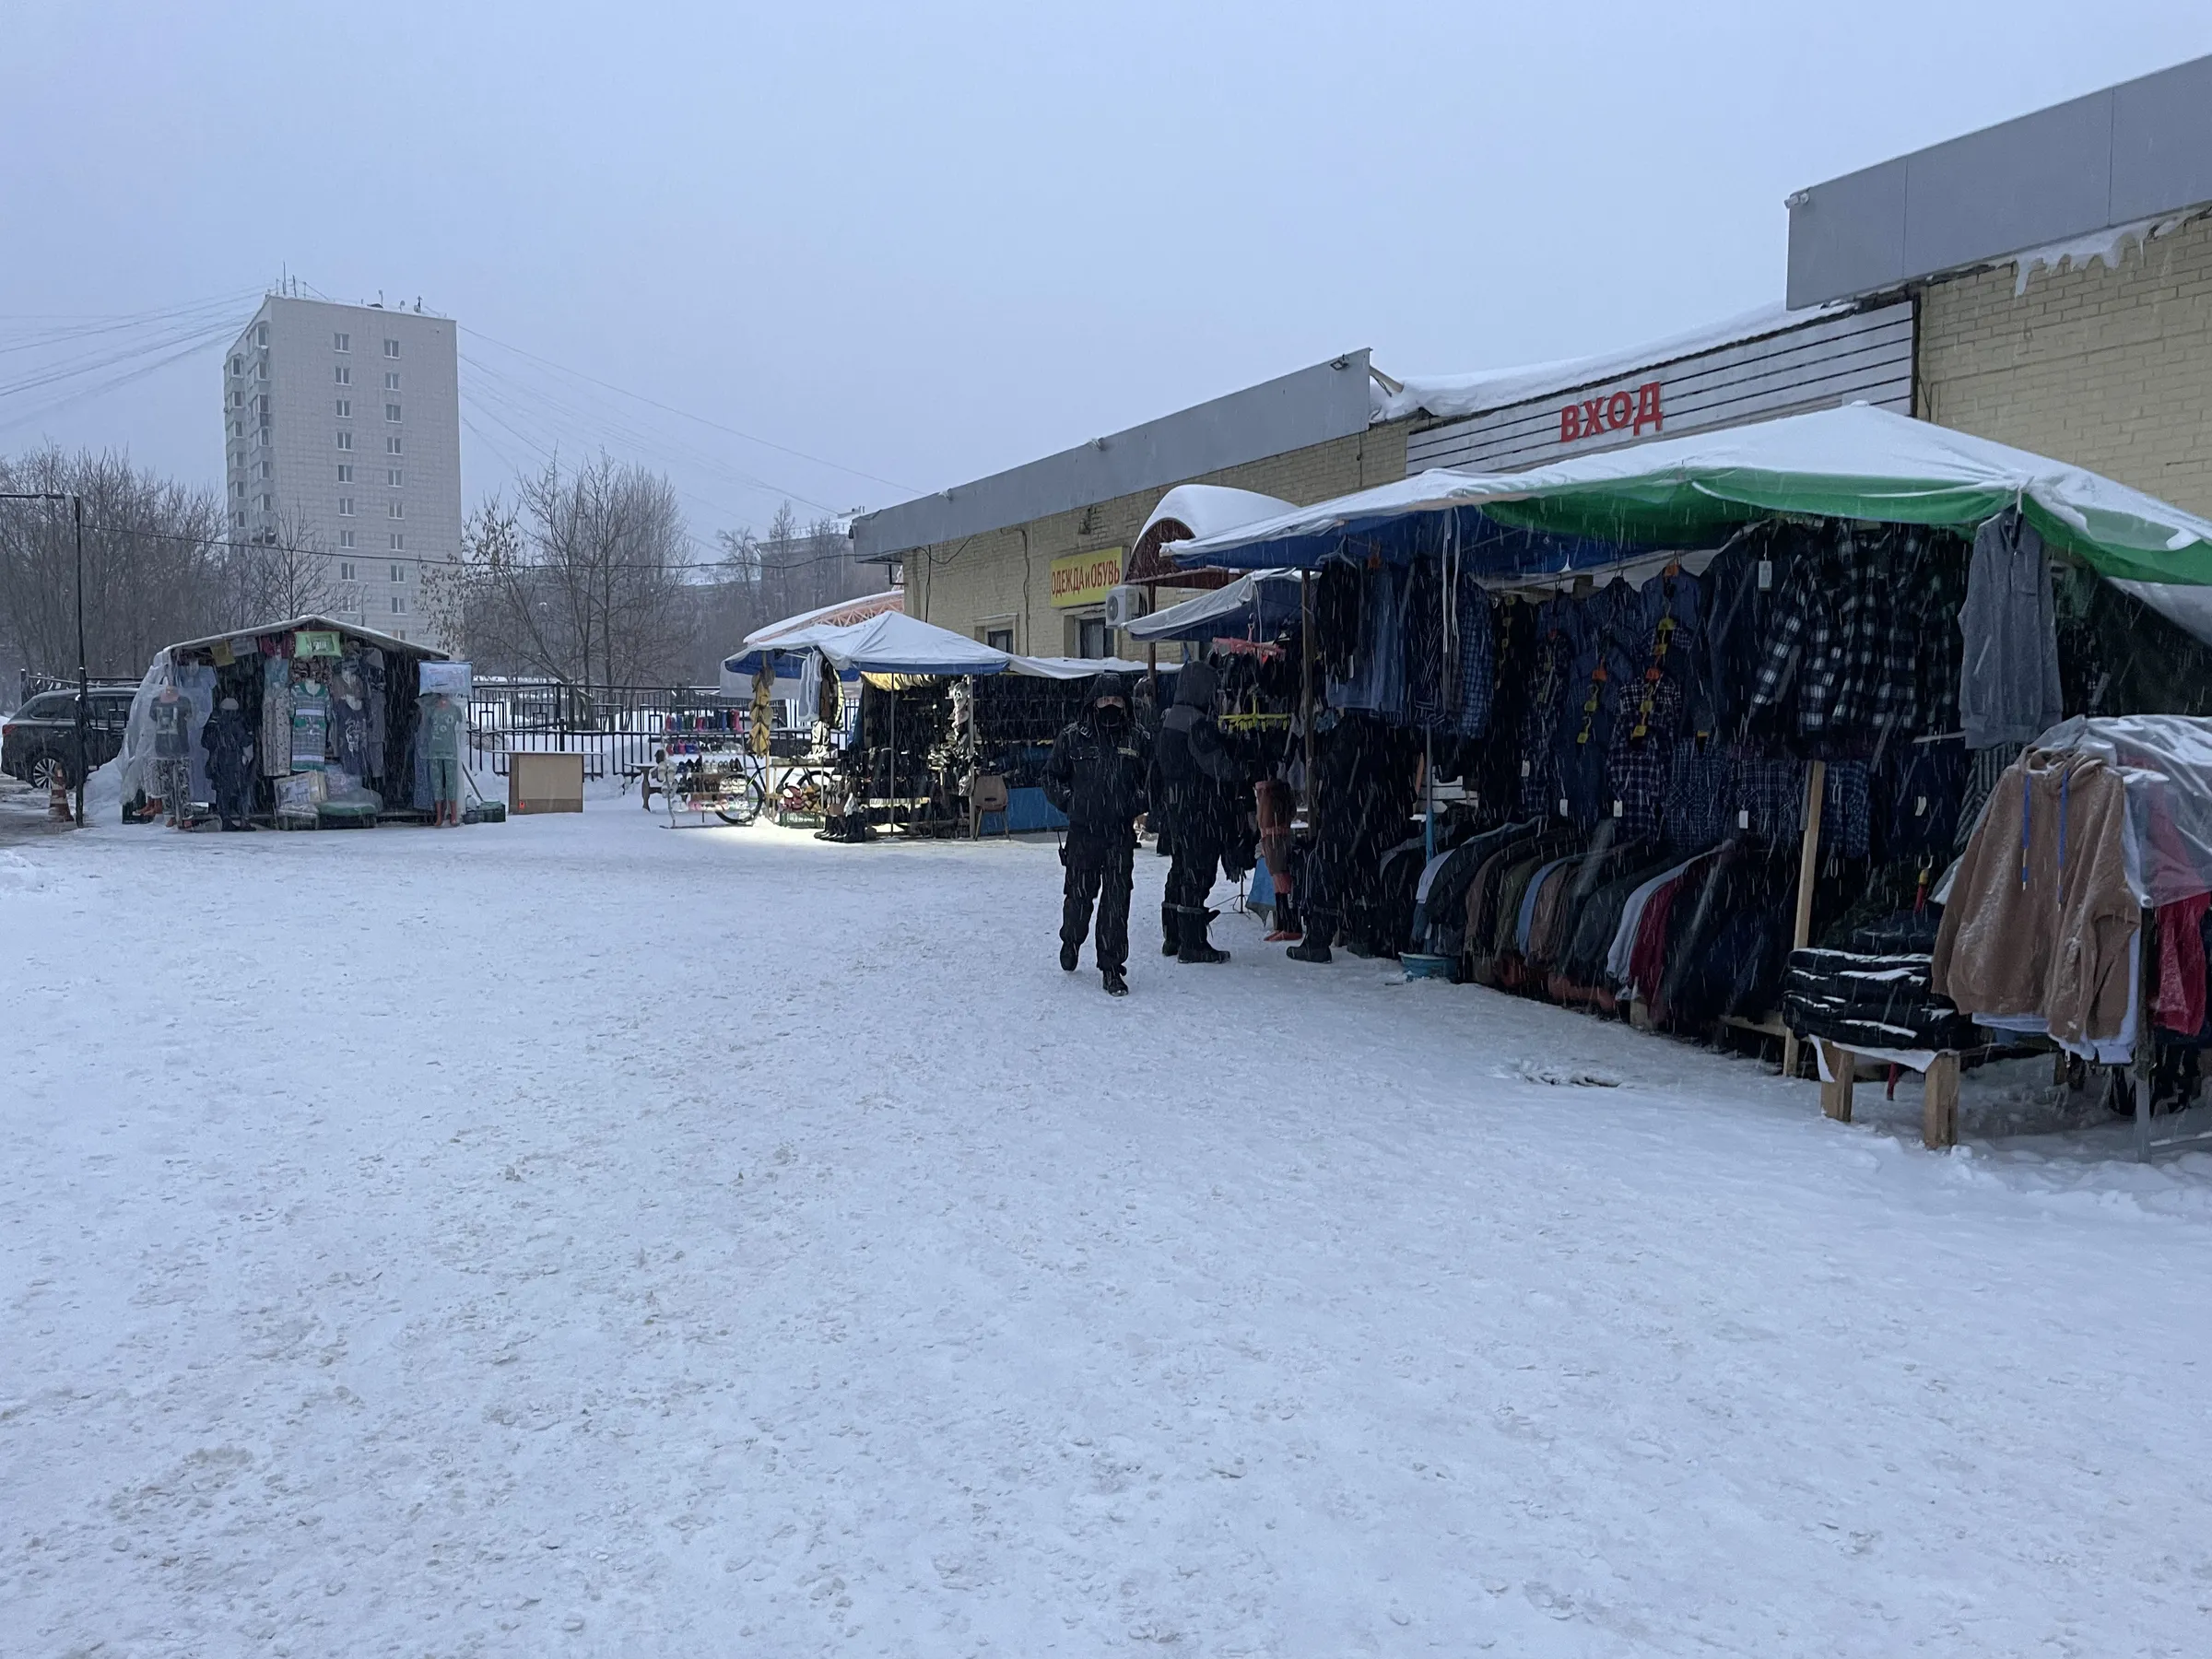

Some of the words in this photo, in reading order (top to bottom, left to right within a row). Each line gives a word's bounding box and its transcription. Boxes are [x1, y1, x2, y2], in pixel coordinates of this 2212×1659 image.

[1559, 381, 1664, 443] ВХОД
[1051, 565, 1085, 598] ОДЕЖДА
[1090, 559, 1121, 588] ОБУВЬ
